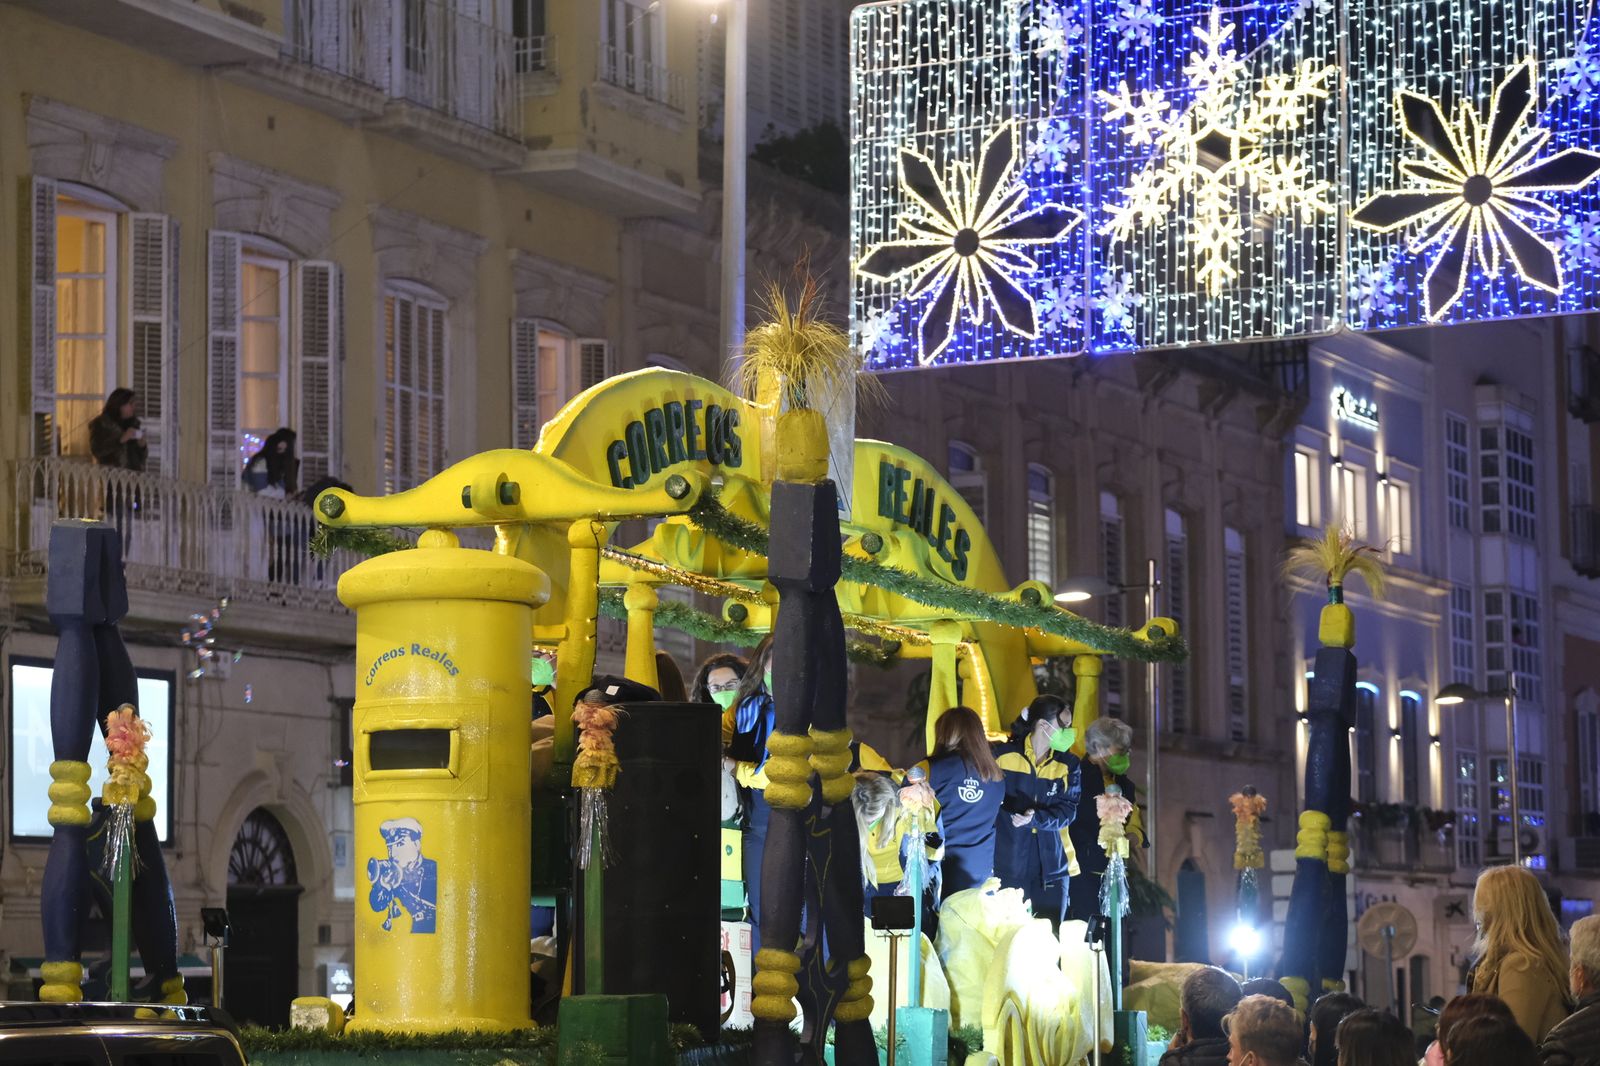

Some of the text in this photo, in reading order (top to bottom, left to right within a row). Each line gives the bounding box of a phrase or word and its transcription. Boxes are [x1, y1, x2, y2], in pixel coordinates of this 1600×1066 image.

[607, 399, 971, 581] CORREOS REALES
[366, 643, 460, 686] Correos Reales
